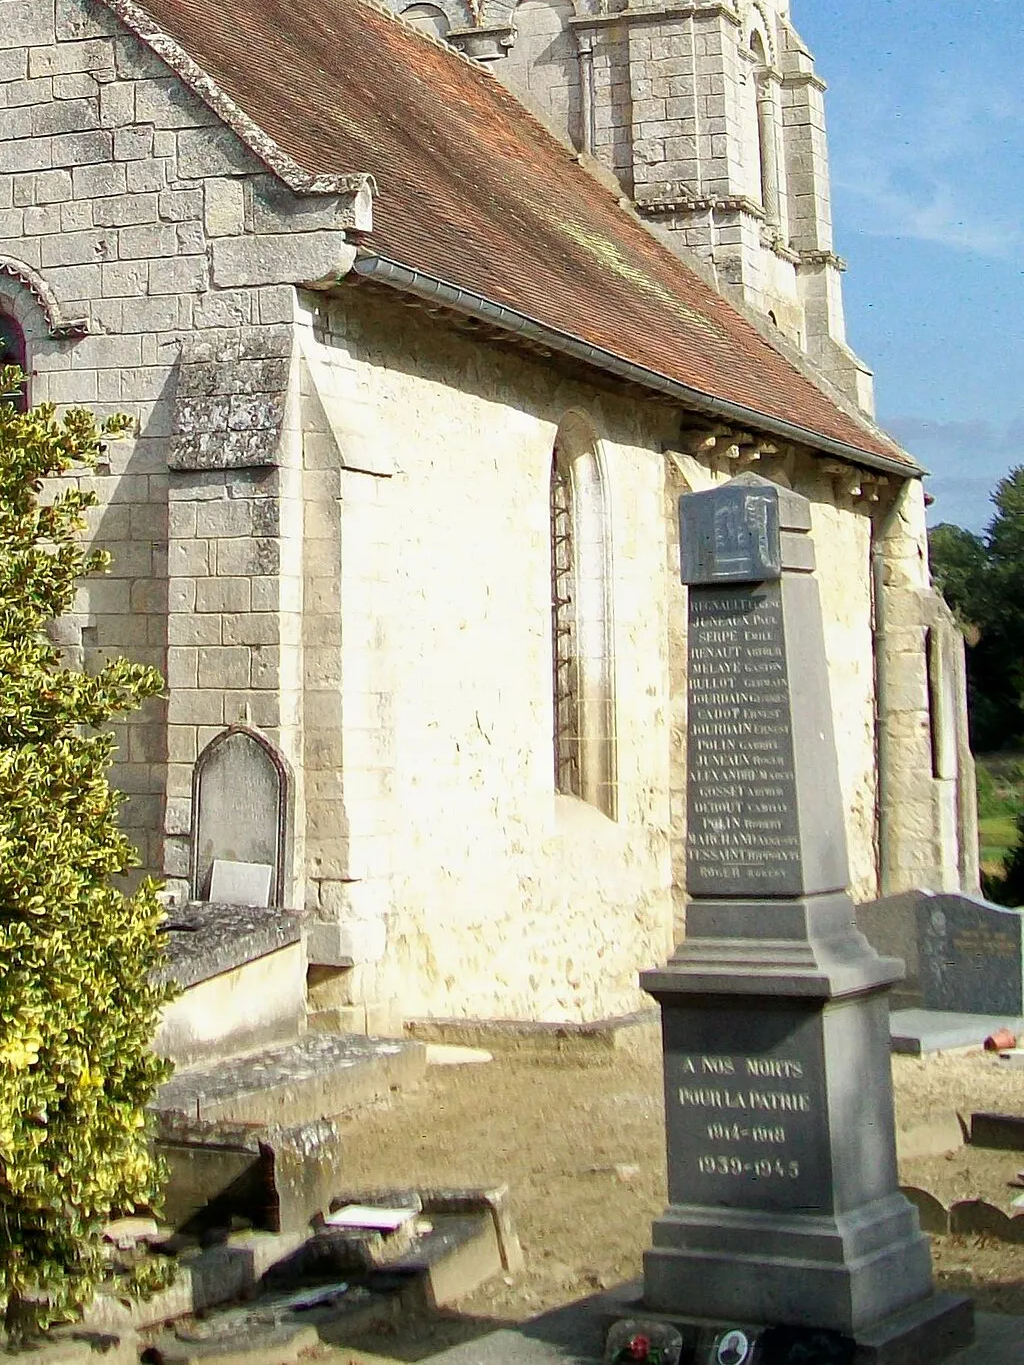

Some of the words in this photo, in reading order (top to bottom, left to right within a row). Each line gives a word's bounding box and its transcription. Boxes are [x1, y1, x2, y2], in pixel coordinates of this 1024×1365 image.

[699, 630, 737, 642] SERPE
[691, 646, 742, 659] RENAUT
[689, 676, 737, 690] BULLOT
[692, 692, 749, 704] JOURDAIN
[691, 722, 752, 735] JOURDAIN
[697, 739, 735, 750] POLIN
[682, 1057, 695, 1074] A
[702, 1055, 735, 1076] NOS
[746, 1057, 804, 1078] MORTS
[678, 1087, 722, 1108] POUR
[724, 1089, 746, 1109] LA
[749, 1090, 810, 1112] PATRIE
